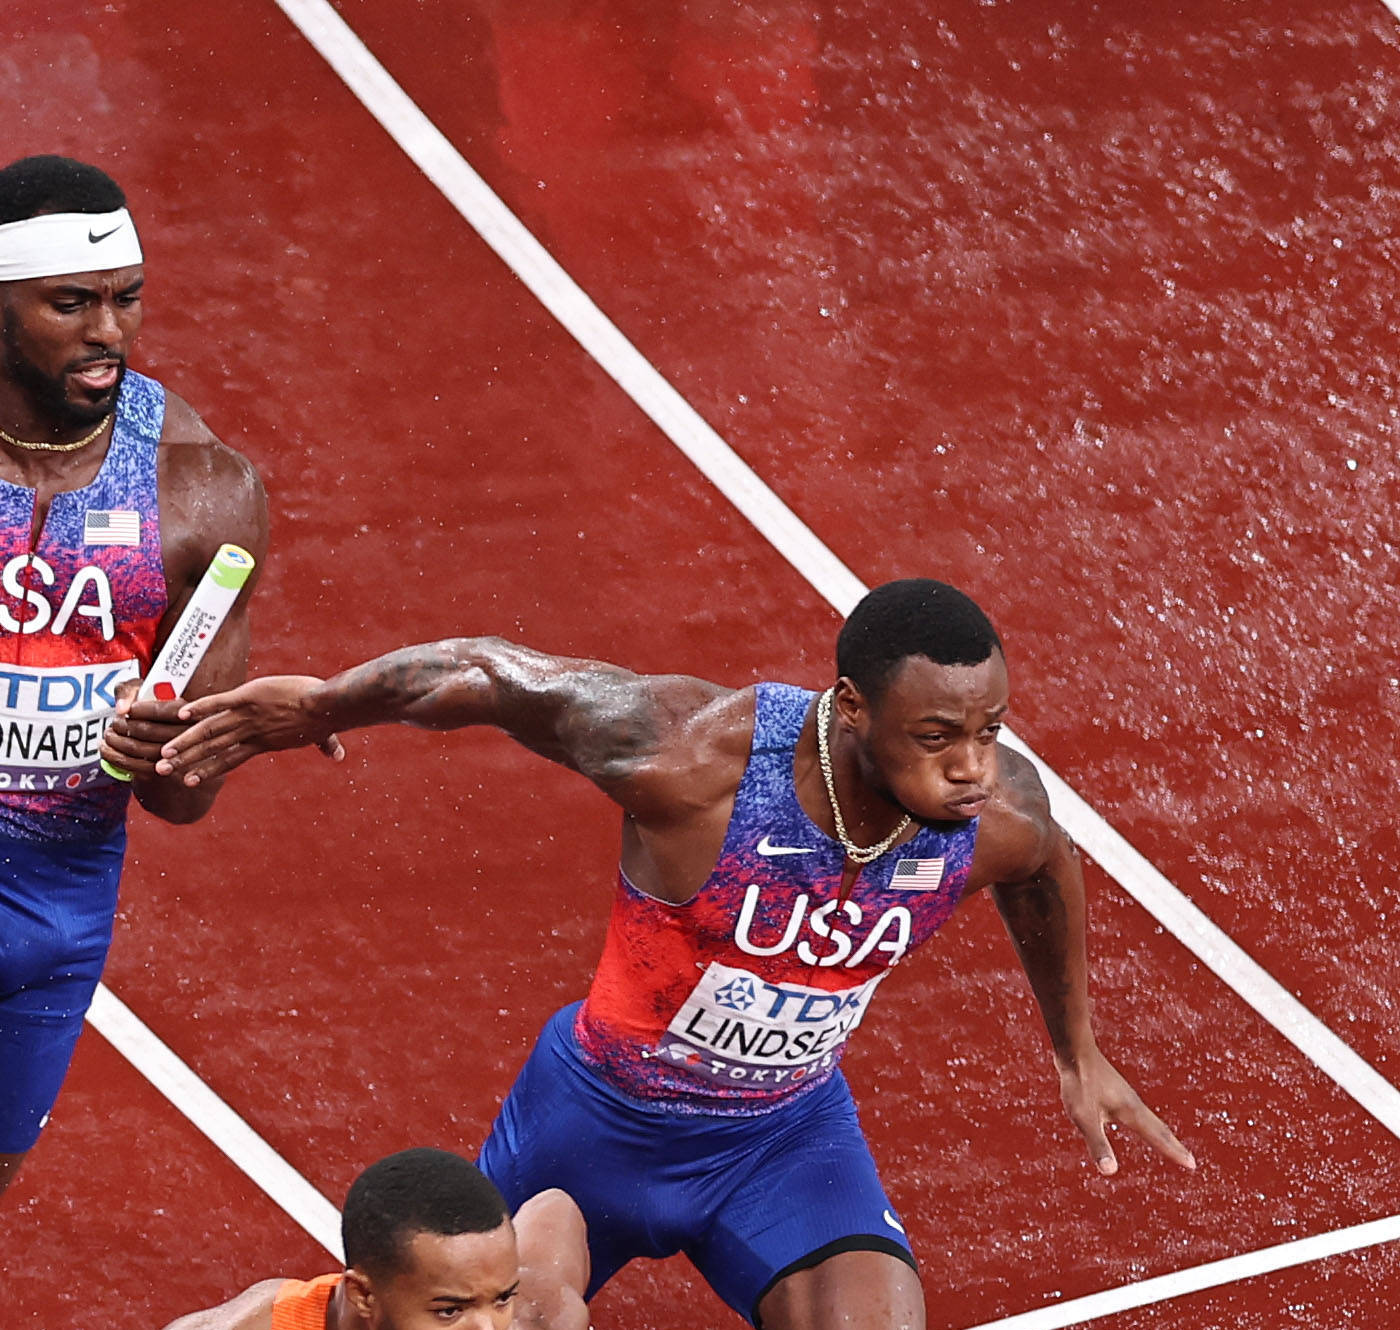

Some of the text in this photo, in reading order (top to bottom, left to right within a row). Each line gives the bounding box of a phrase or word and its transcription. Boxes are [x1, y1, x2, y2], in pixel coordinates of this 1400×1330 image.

[170, 611, 208, 677] CHAMPIONSHIPS
[734, 884, 912, 967] USA
[763, 983, 863, 1022] TDK
[684, 1008, 856, 1061] LINDSEY
